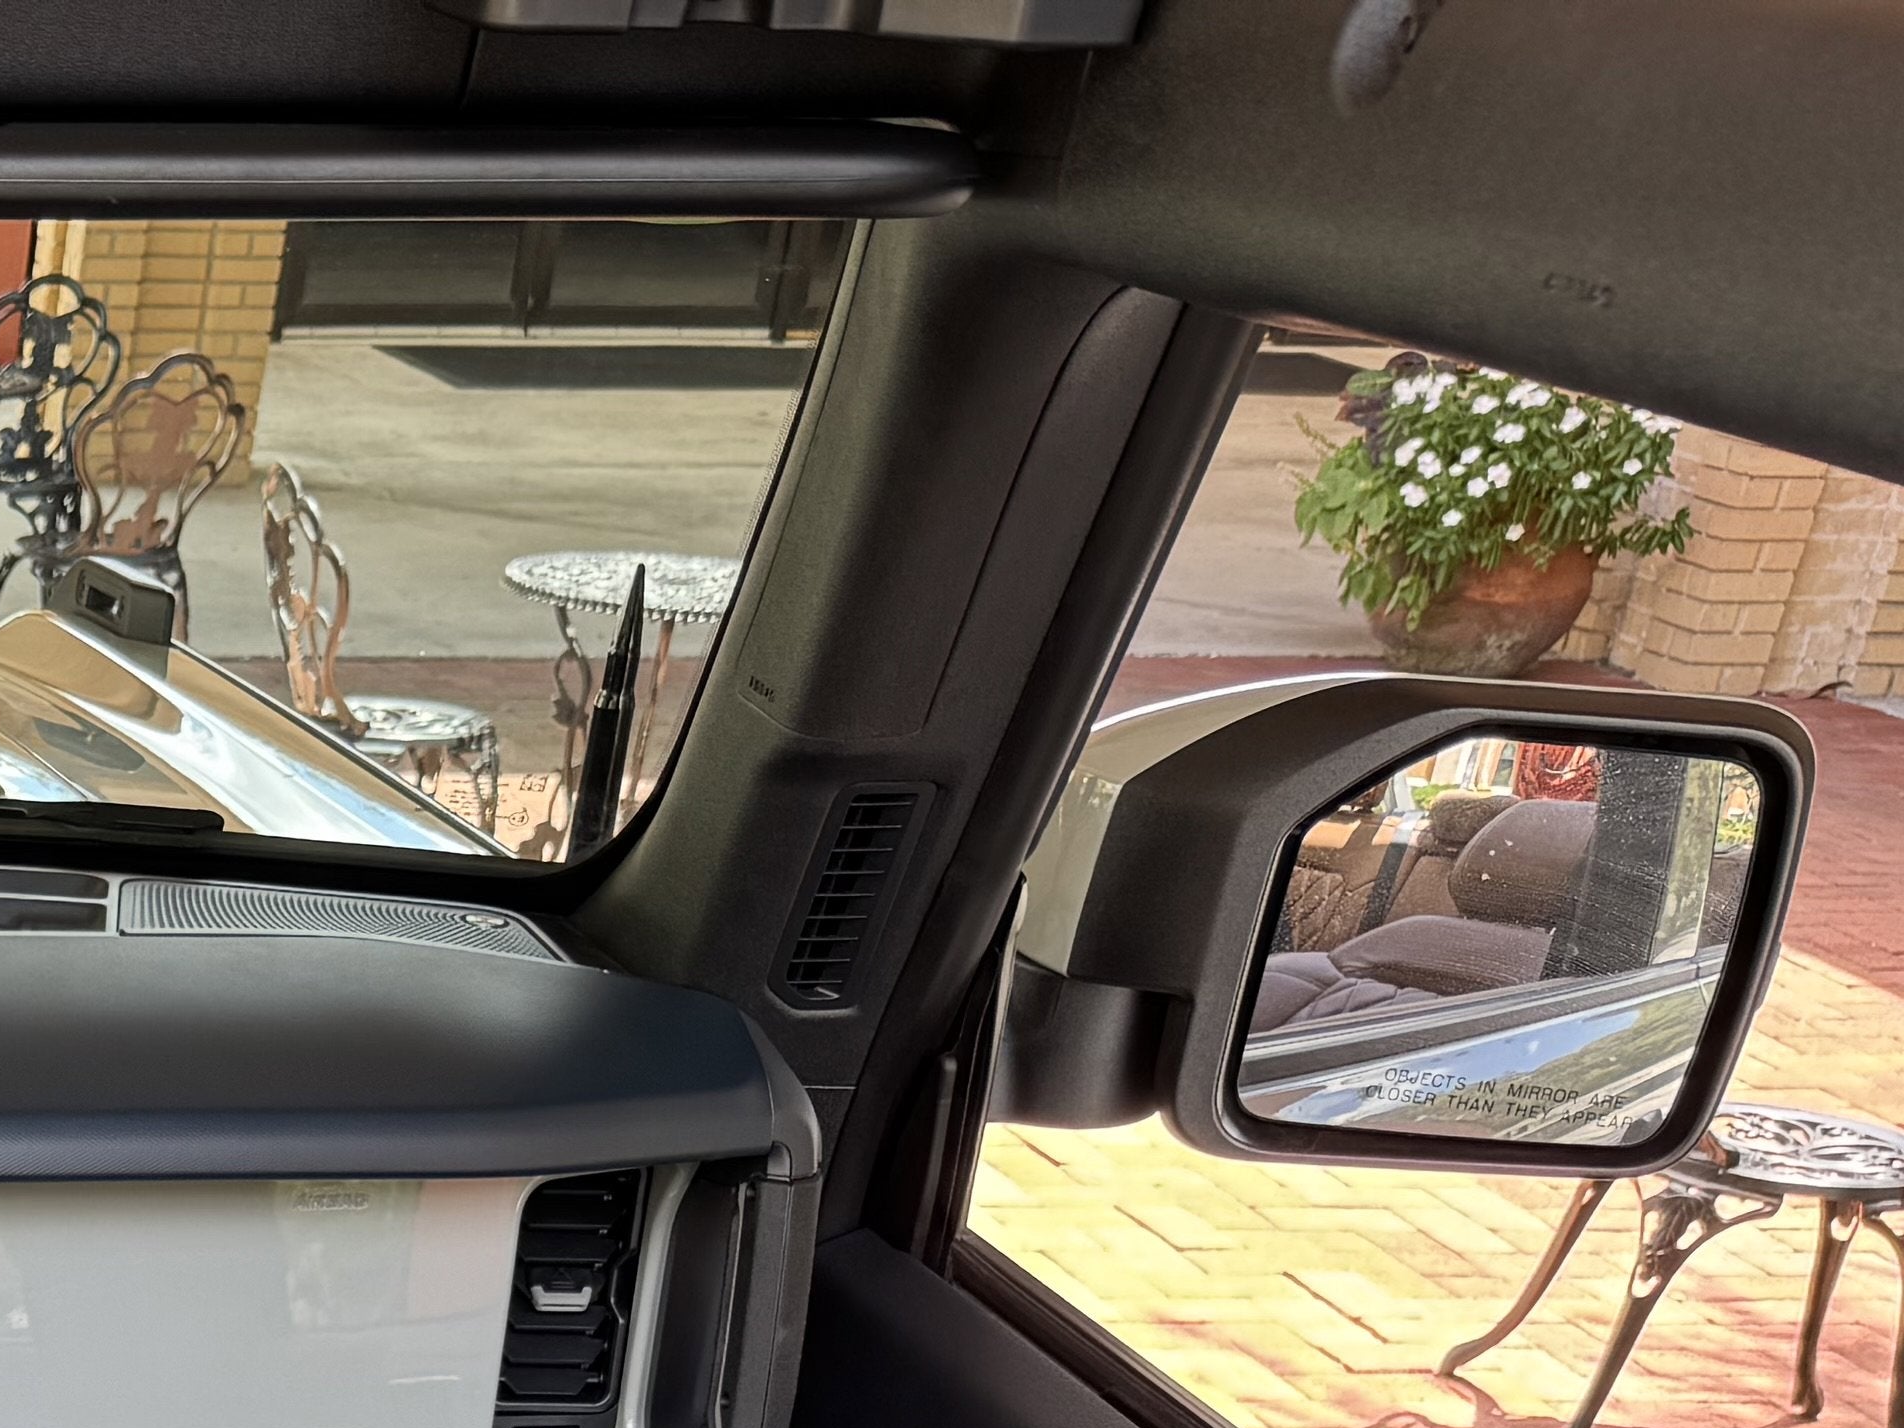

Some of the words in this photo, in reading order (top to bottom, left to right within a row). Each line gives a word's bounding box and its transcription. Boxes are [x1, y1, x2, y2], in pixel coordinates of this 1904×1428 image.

[1365, 1084, 1437, 1106] CLOSER
[1447, 1095, 1495, 1112] THAN
[1505, 1102, 1551, 1120] THEY
[1560, 1109, 1633, 1129] APPEAR
[1384, 1068, 1466, 1090] OBJECTS
[1477, 1081, 1496, 1094] IN
[1506, 1083, 1579, 1105] MIRROR
[1589, 1094, 1630, 1109] ARE
